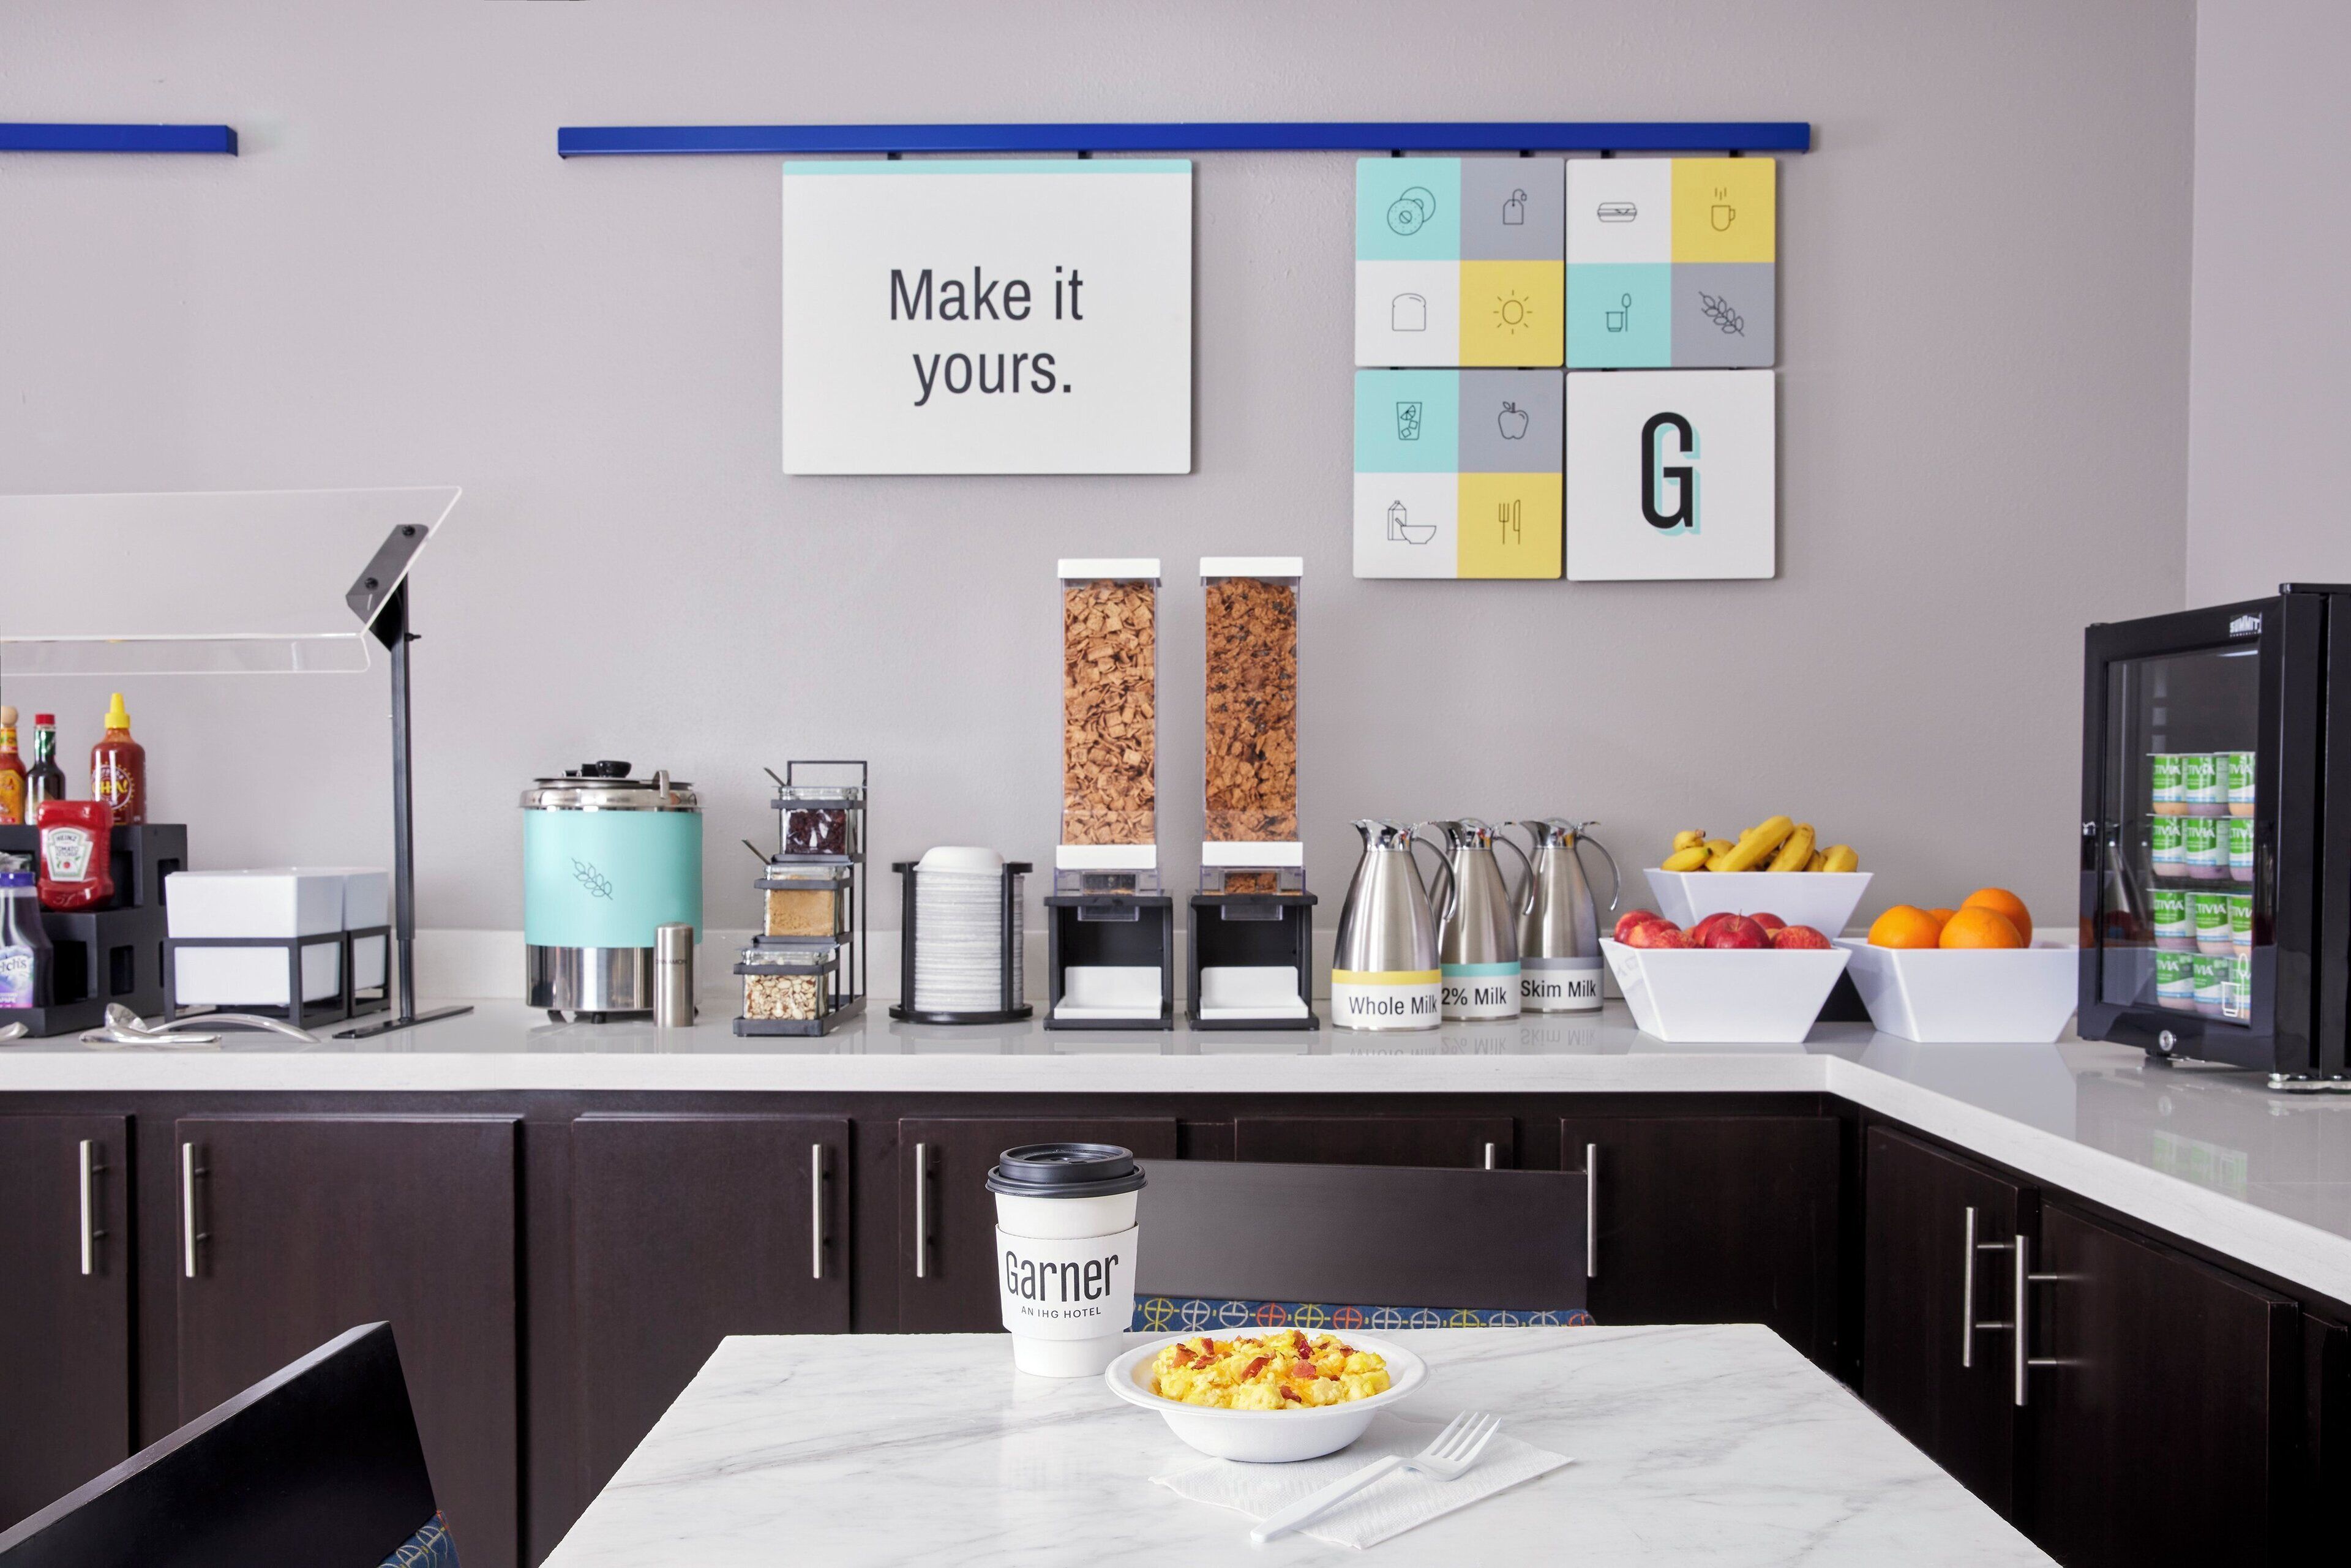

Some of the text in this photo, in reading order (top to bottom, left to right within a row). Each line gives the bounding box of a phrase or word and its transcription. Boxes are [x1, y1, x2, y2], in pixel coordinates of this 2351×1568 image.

[890, 266, 1084, 321] Make it
[912, 353, 1072, 407] yours.
[1641, 411, 1701, 536] G
[1349, 994, 1438, 1015] Whole Milk
[1441, 987, 1507, 1006] 2% Milk
[1520, 980, 1596, 998] Skim Milk
[1006, 1250, 1119, 1302] Garner
[1021, 1306, 1101, 1318] AN IHG HOTEL
